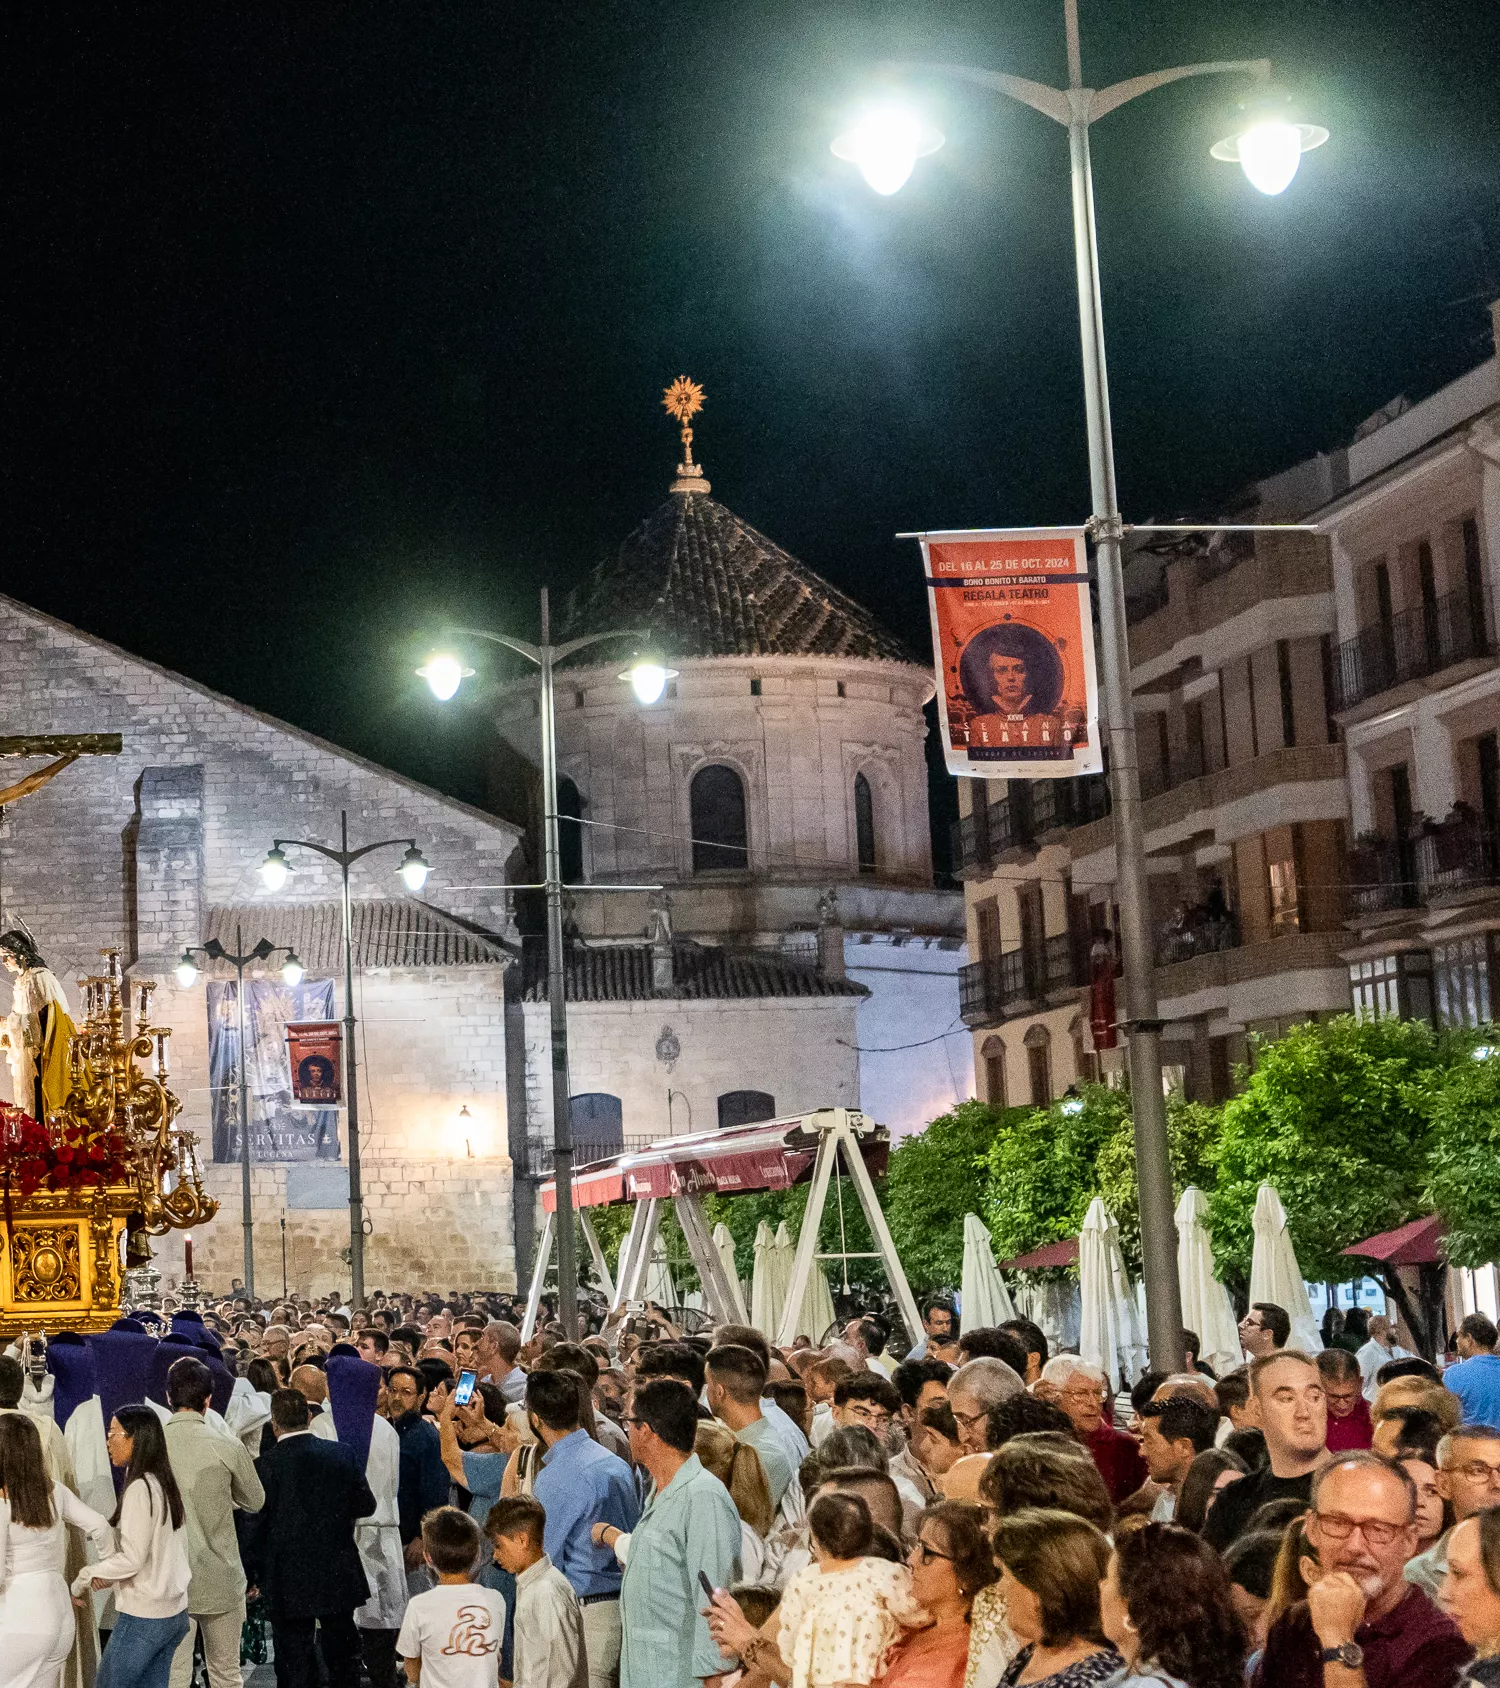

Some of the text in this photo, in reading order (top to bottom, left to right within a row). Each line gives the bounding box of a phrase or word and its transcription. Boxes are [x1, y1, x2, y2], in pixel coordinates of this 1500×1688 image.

[939, 557, 1070, 572] DEL 16 AL 25 DE OCT. 2024
[963, 576, 1046, 586] BONO BONITO Y BARATO
[963, 587, 1049, 600] REGALA TEATRO
[964, 720, 1070, 731] SEMANA
[963, 730, 1072, 742] TEATRO
[235, 1133, 316, 1146] SERVITAS
